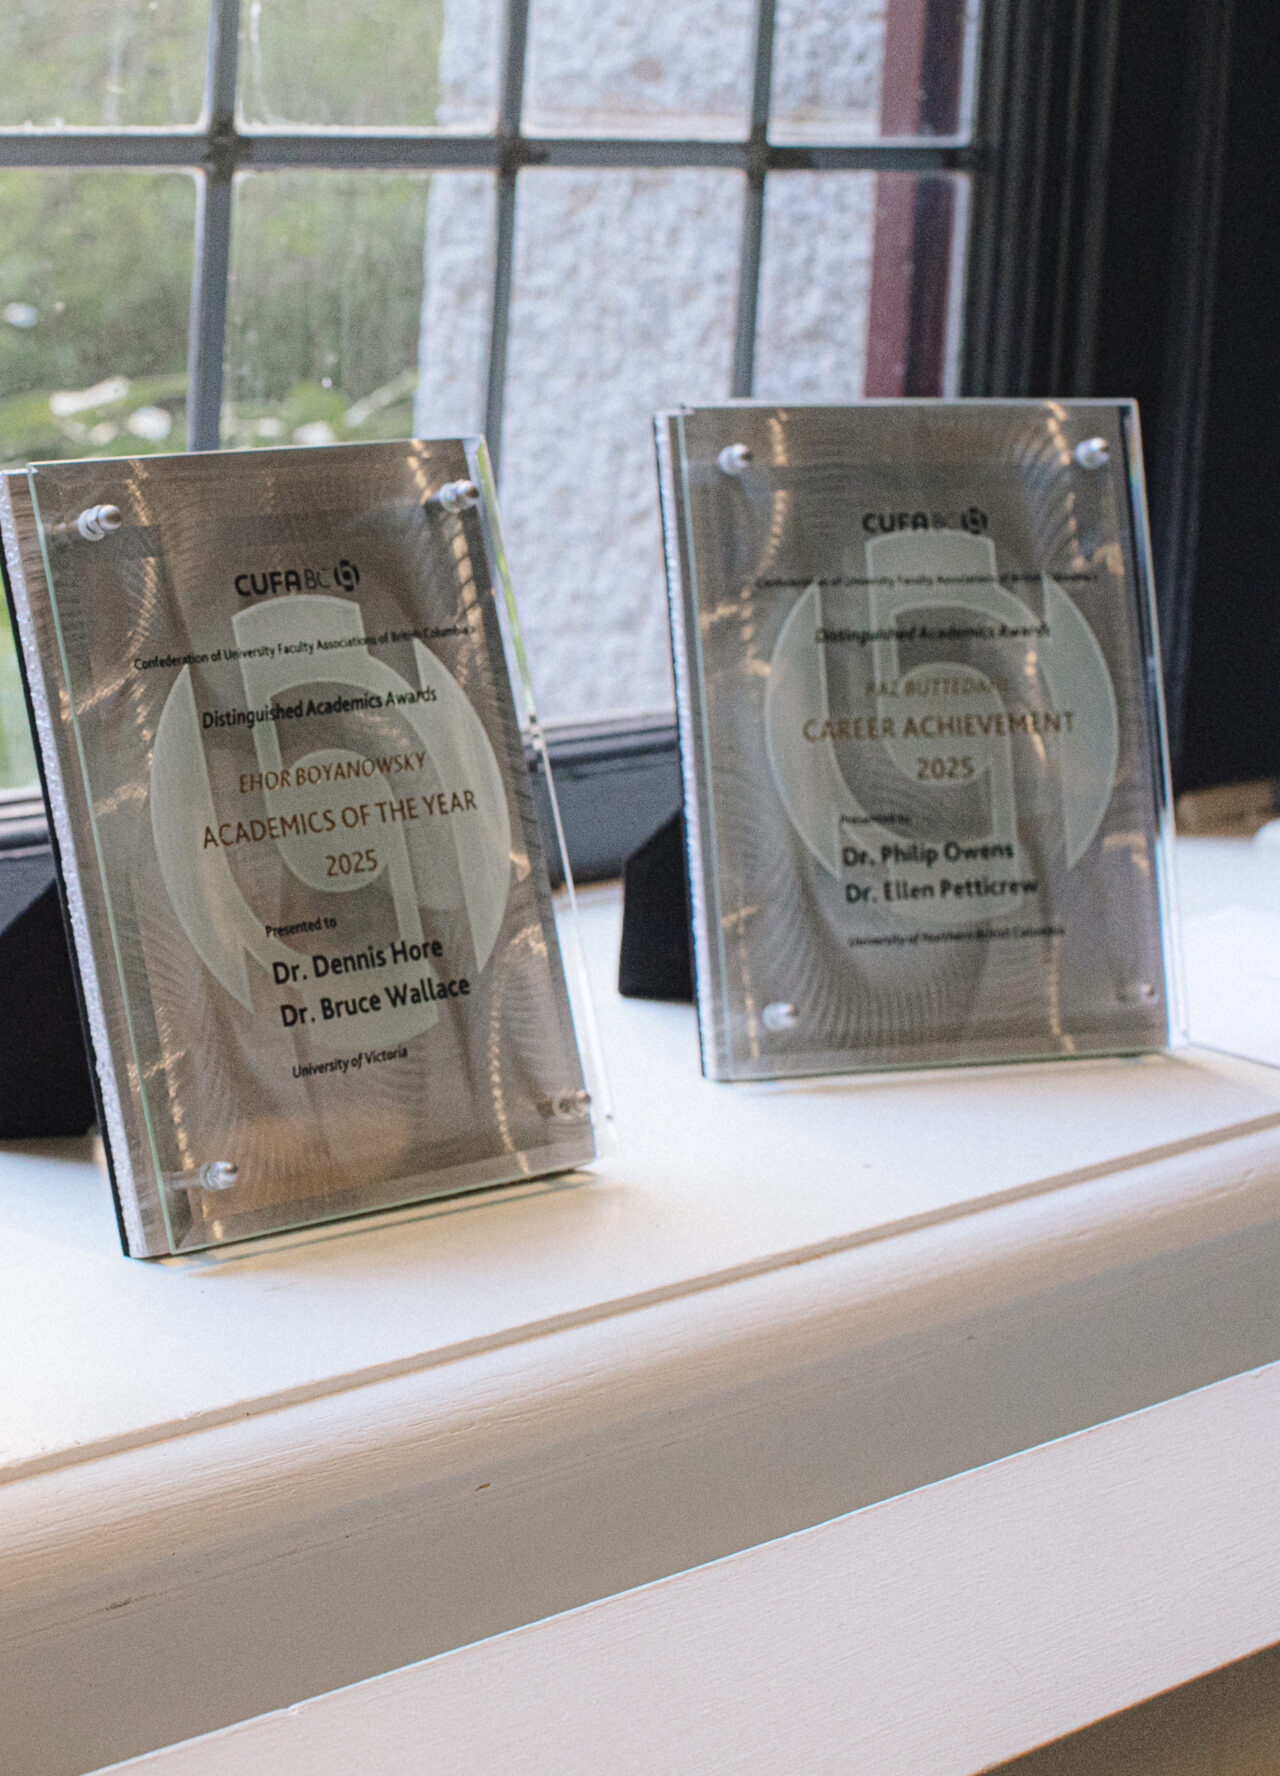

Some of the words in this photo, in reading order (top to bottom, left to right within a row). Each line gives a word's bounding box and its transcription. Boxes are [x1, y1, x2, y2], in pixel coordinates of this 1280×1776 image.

[210, 650, 222, 662] of
[277, 640, 314, 657] Faculty
[202, 699, 303, 730] Distinguished
[305, 692, 383, 717] Academics
[385, 685, 438, 706] Awards
[802, 717, 896, 743] CAREER
[902, 709, 1075, 738] ACHIEVEMENT
[239, 768, 291, 794] EHOR
[296, 752, 426, 786] BOYANOWSKY
[917, 756, 974, 780] 2025
[203, 809, 336, 849] ACADEMICS
[341, 801, 373, 828] OF
[375, 795, 419, 822] THE
[424, 790, 477, 816] YEAR
[326, 849, 378, 877] 2025
[842, 846, 876, 867] Dr.
[880, 842, 939, 868] Philip
[944, 840, 1014, 862] Owens
[845, 883, 878, 904] Dr.
[883, 878, 935, 901] Ellen
[940, 875, 1039, 898] Petticrew
[265, 919, 322, 938] Presented
[323, 916, 337, 930] to
[273, 961, 308, 985] Dr.
[312, 945, 386, 978] Dennis
[390, 937, 444, 964] Hore
[280, 1004, 316, 1028] Dr.
[321, 990, 382, 1021] Bruce
[385, 974, 471, 1010] Wallace
[292, 1056, 349, 1078] University
[351, 1052, 365, 1068] of
[365, 1045, 408, 1064] Victoria
